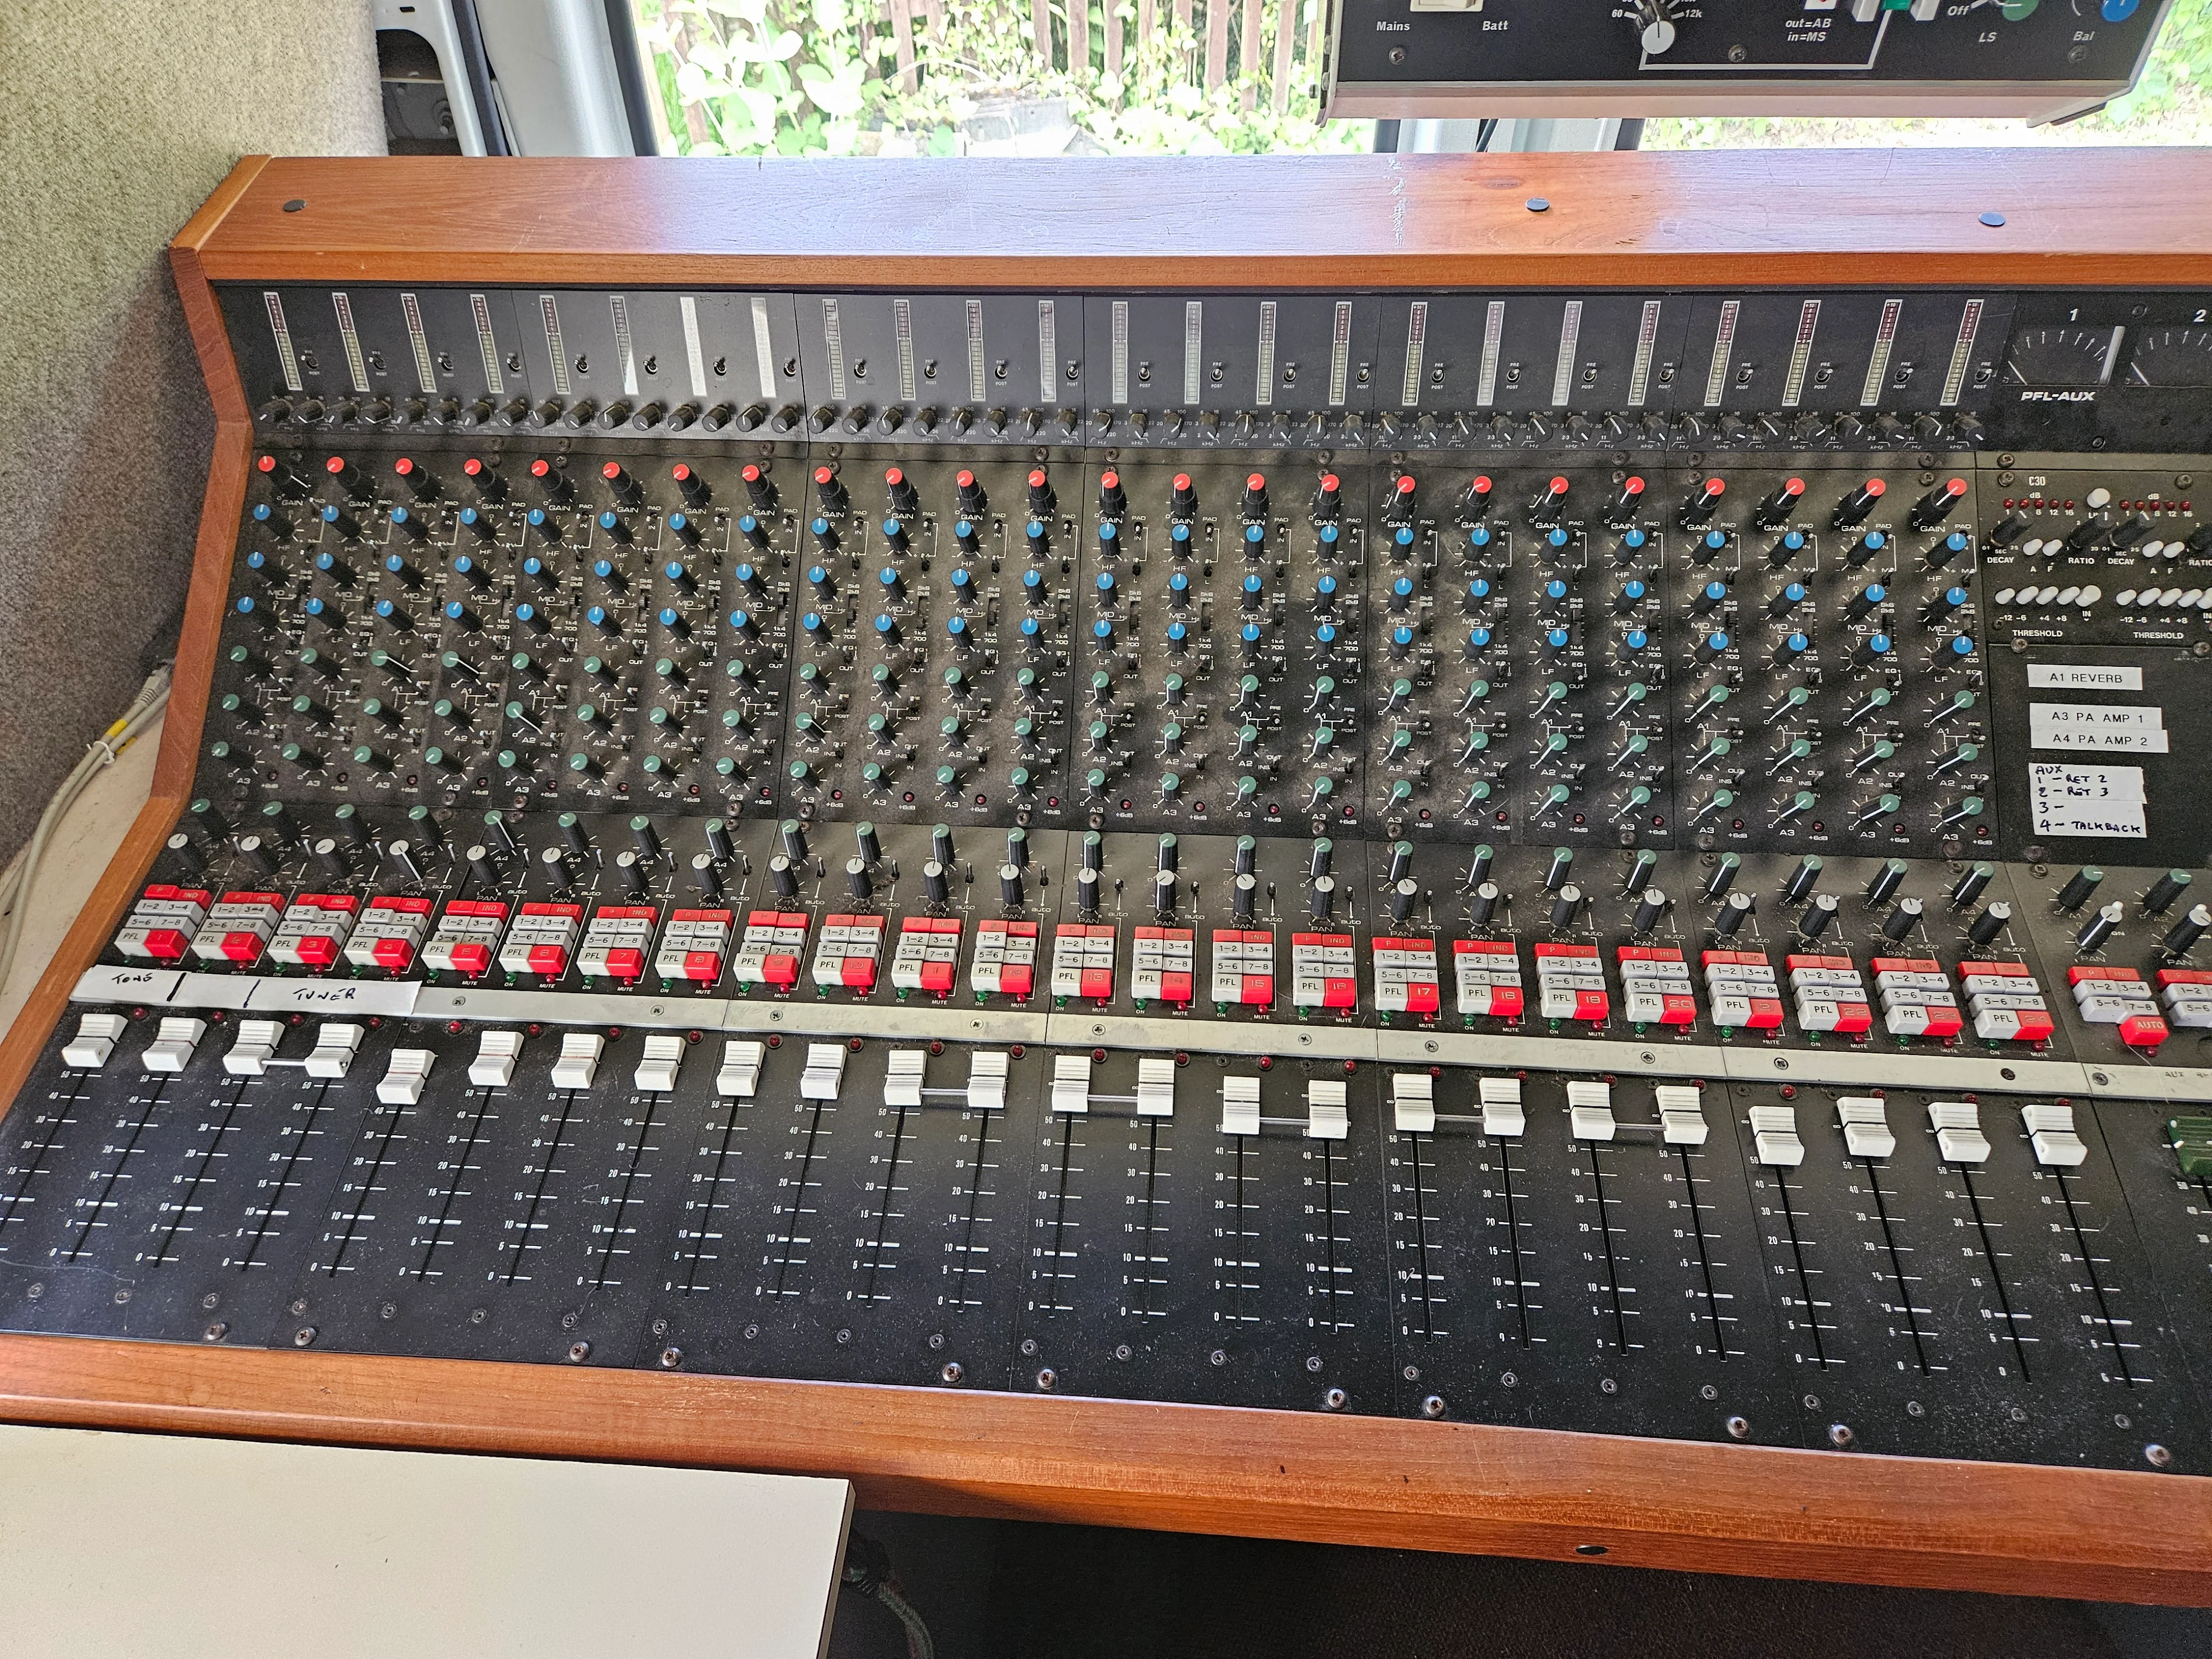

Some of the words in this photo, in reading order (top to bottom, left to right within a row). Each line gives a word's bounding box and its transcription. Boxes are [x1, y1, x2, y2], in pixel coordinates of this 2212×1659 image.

[1611, 9, 1623, 18] 60
[1686, 9, 1703, 18] 12k
[1947, 6, 1970, 15] Off
[1376, 21, 1410, 32] Mains
[1482, 20, 1509, 32] Batt
[1785, 18, 1832, 29] out=AB
[1787, 31, 1827, 43] in=MS
[1979, 32, 1997, 43] LS
[2073, 31, 2095, 41] Bal
[2070, 309, 2078, 321] 1
[2193, 309, 2206, 322] 2
[2021, 392, 2096, 401] PFL-AUX
[2029, 476, 2046, 486] C30
[2050, 673, 2064, 681] A1
[2072, 674, 2122, 683] REVERB
[2052, 712, 2068, 720] A3
[2077, 713, 2094, 722] PA
[2103, 714, 2129, 722] AMP
[2053, 734, 2070, 742] A4
[2079, 735, 2095, 744] PA
[2105, 736, 2132, 744] AMP
[2141, 737, 2147, 745] 2
[2035, 765, 2063, 774] AUX
[2065, 774, 2090, 783] RET
[2038, 787, 2048, 797] 2
[2067, 786, 2091, 796] RET
[2100, 787, 2108, 796] 3
[2039, 802, 2049, 813] 3
[2040, 819, 2051, 831] 4
[2071, 821, 2141, 833] TALKBACK
[1250, 979, 1265, 988] 15
[293, 988, 356, 1000] TUNER
